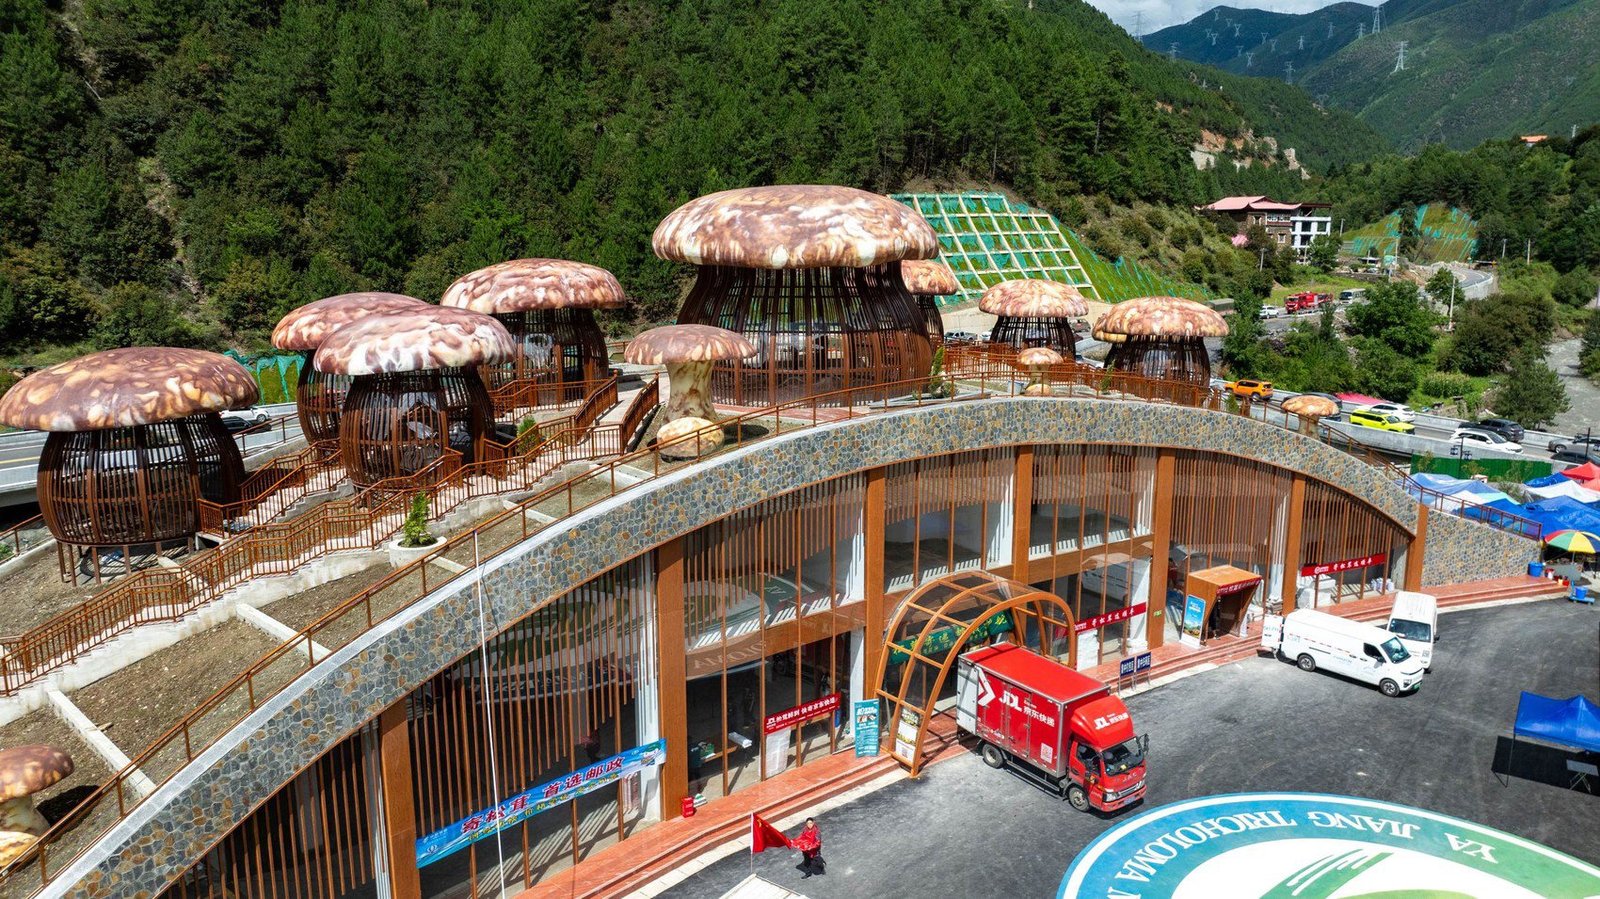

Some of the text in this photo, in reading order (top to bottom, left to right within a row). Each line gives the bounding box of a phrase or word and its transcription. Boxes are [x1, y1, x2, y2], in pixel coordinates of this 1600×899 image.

[998, 690, 1022, 711] JDL
[1023, 706, 1055, 727] 京东快递
[461, 792, 531, 833] 寄松茸
[542, 756, 625, 798] 首选邮政
[1114, 810, 1499, 882] YA JIANG TRICHOLOMA
